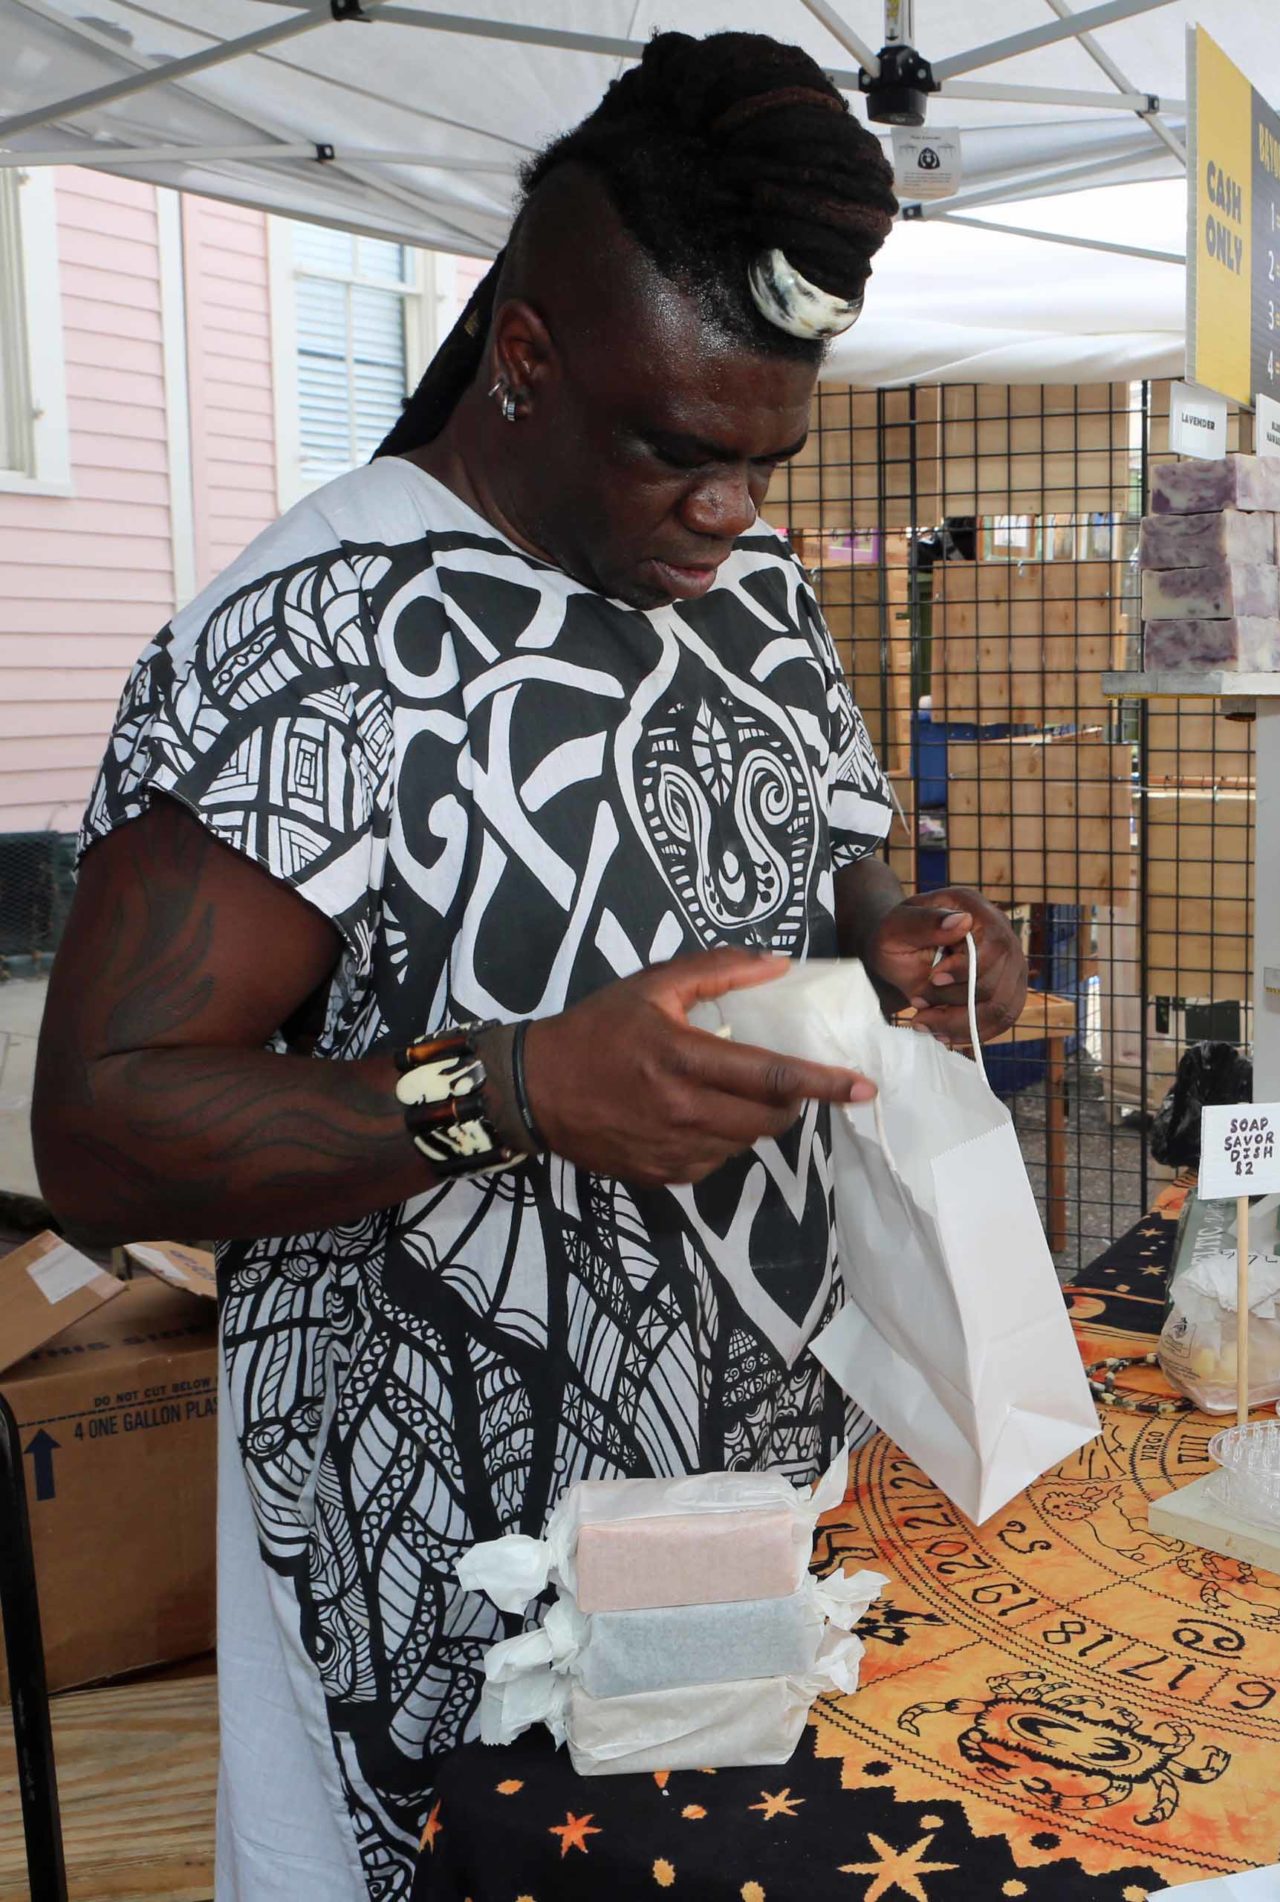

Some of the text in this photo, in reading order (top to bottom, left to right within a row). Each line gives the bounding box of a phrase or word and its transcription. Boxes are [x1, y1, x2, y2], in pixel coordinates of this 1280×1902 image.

[1206, 160, 1242, 225] CASH
[1206, 214, 1242, 276] ONLY
[1181, 413, 1216, 431] LAVENDER
[1224, 1131, 1275, 1152] SAVOR
[1230, 1117, 1269, 1134] SOAP
[1230, 1148, 1273, 1163] DISH
[1234, 1161, 1254, 1176] $2
[94, 1377, 212, 1408] DO NOT CUT BELOW
[74, 1422, 84, 1441] 4
[89, 1416, 119, 1439] ONE
[123, 1403, 182, 1432] GALLON
[1139, 1430, 1165, 1462] VIRGO
[897, 1502, 957, 1530] 21
[925, 1538, 992, 1575] 20
[972, 1582, 1039, 1616] 19
[1042, 1620, 1114, 1658] 18
[1117, 1654, 1196, 1691] 17
